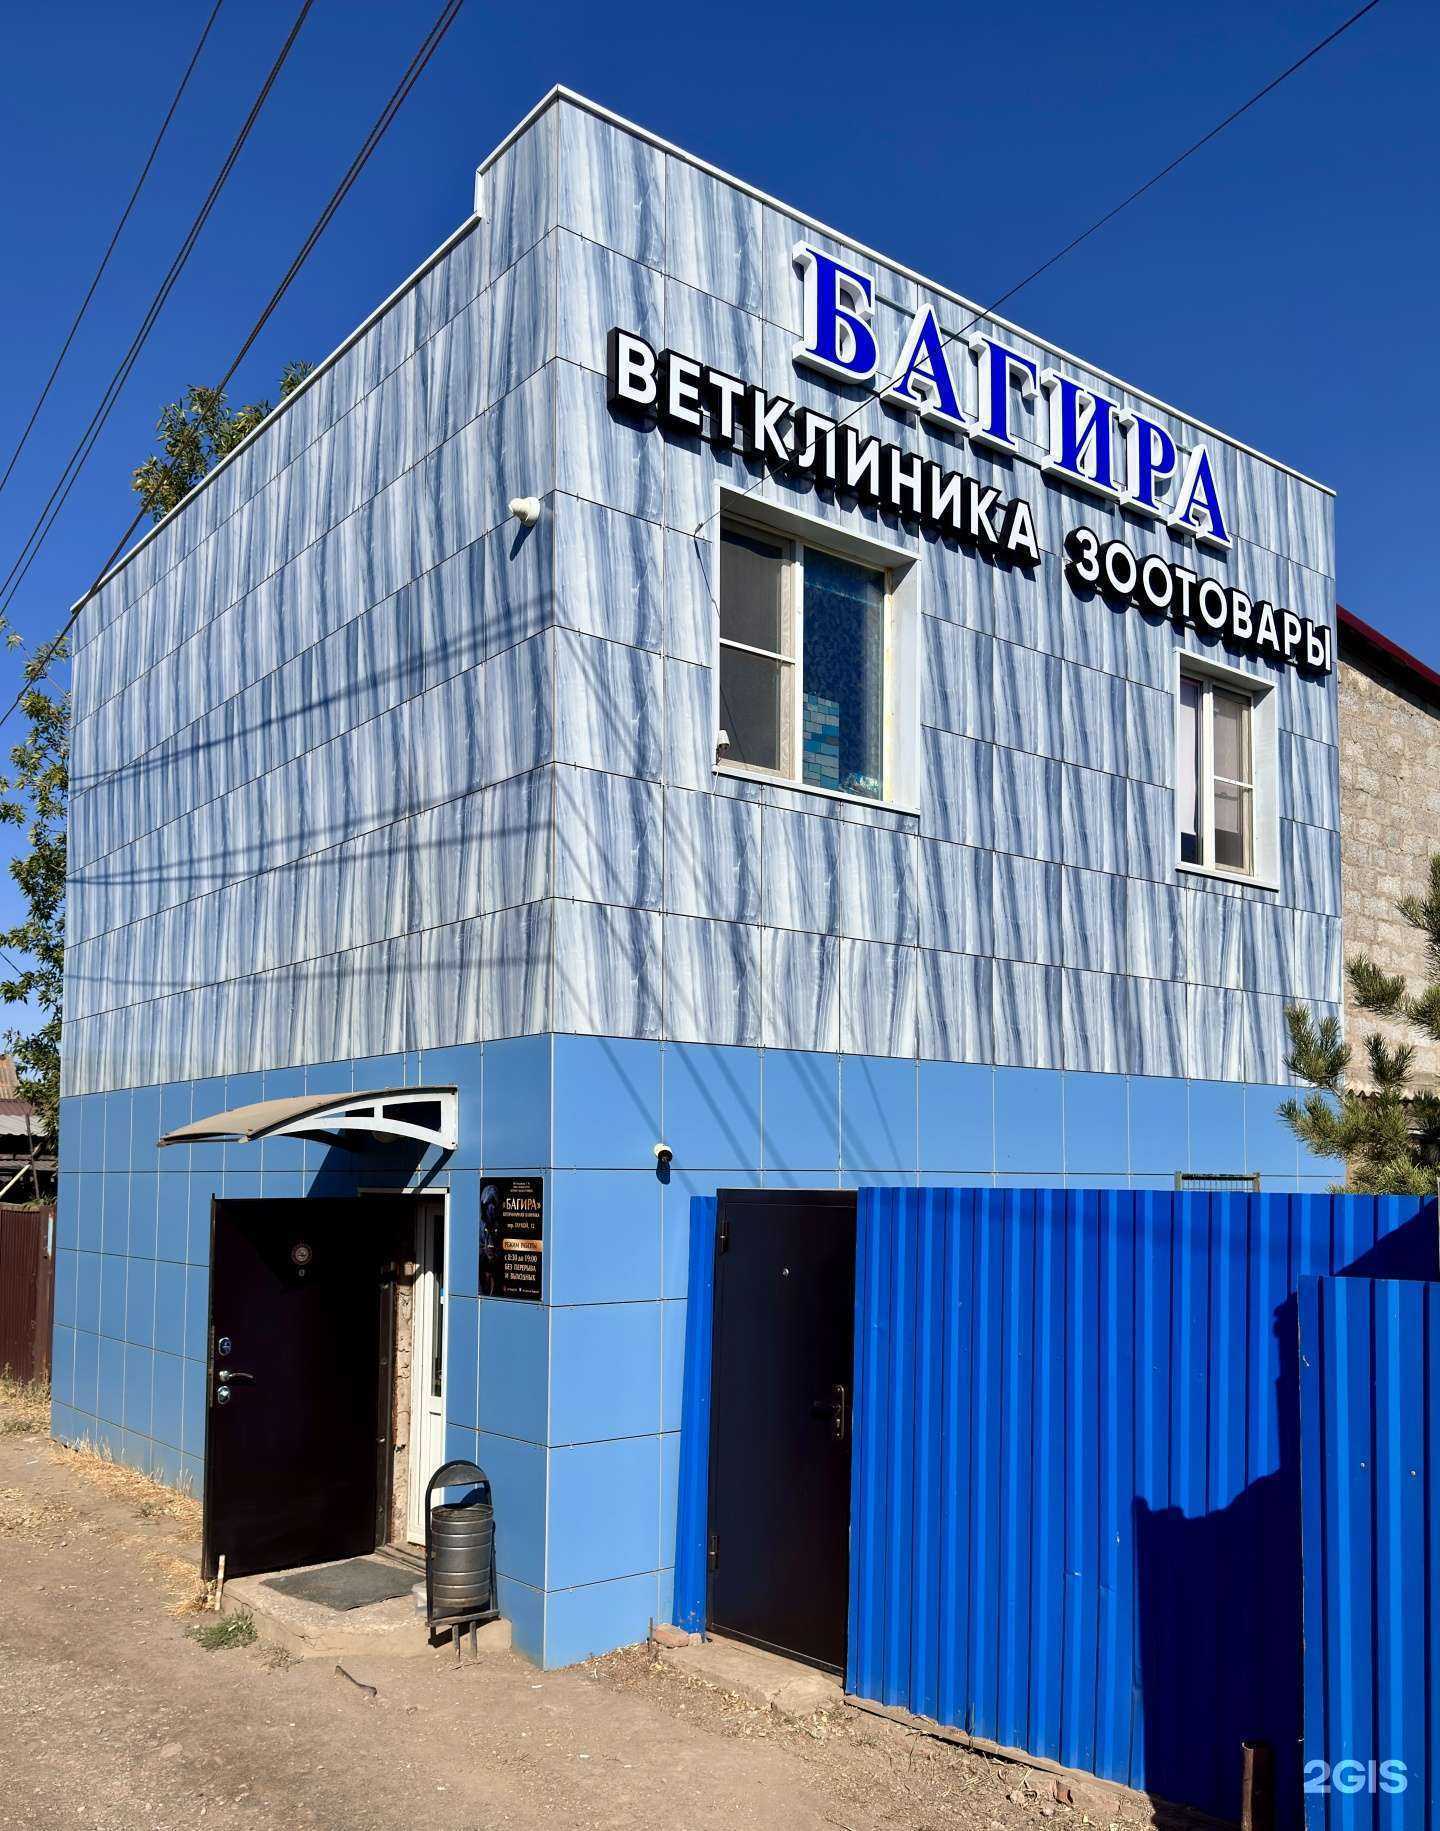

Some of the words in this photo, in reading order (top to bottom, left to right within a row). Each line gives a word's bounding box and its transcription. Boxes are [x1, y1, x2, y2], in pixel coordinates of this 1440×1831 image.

[616, 331, 1040, 561] ВЕТКЛИНИКА
[793, 241, 1232, 549] БАГИРА
[1074, 528, 1332, 672] ЗООТОВАРЫ
